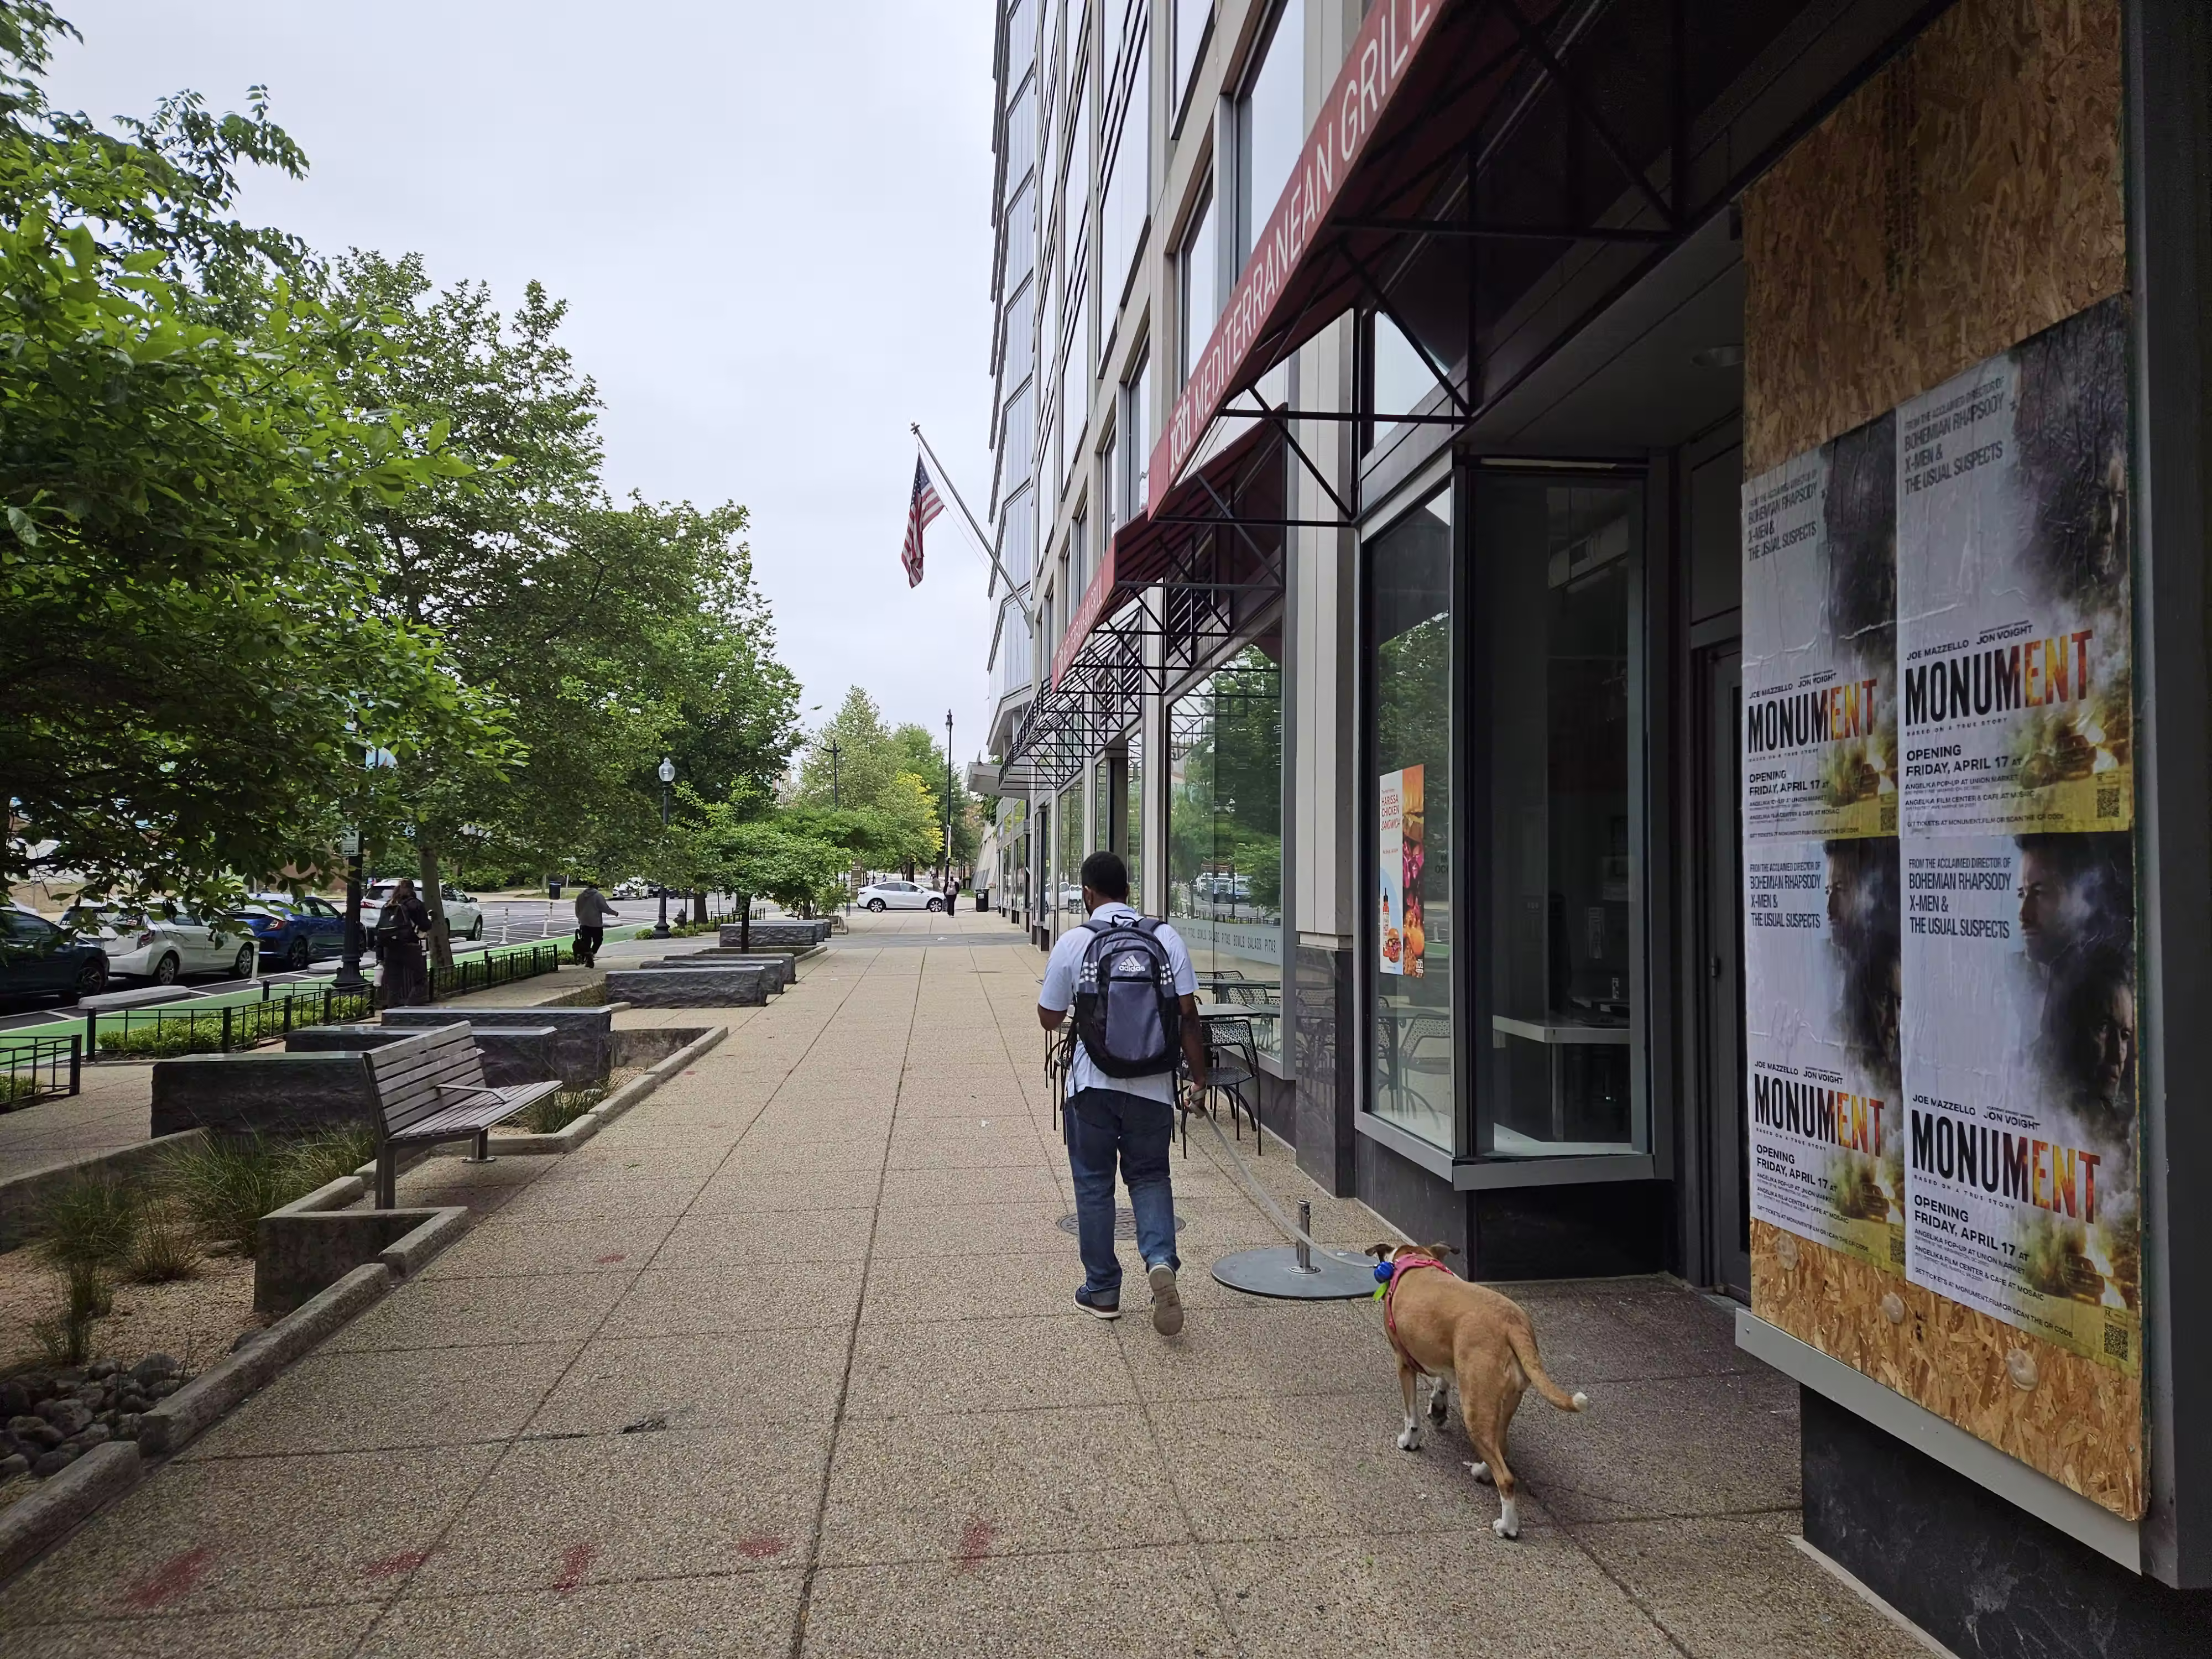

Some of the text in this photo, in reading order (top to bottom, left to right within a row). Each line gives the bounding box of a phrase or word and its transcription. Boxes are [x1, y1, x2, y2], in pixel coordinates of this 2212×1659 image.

[1194, 122, 1332, 432] MEDITERRANEAN
[1341, 0, 1430, 161] GRILL
[1905, 392, 2004, 452] BOHEMIAN RHAPSODY
[1905, 444, 1943, 474] X-MEN &
[1905, 440, 2002, 495] THE USUAL SUSPECTS
[1748, 545, 1760, 561] THE
[1782, 521, 1816, 547] SUSPECTS
[1976, 633, 1995, 645] JON
[1997, 625, 2033, 640] VOIGHT
[1907, 640, 1969, 661] JOE MAZZELLO
[1906, 629, 2093, 726] MONUMENT
[1749, 678, 1877, 753] MONUMENT
[1907, 744, 1961, 761] OPENING
[1750, 770, 1786, 783] OPENING
[1906, 761, 1950, 777] FRIDAY,
[1954, 758, 1991, 773] APRIL
[1995, 756, 2008, 768] 17
[1750, 784, 1778, 796] FRIDAY,
[1781, 781, 1807, 792] APRIL
[1811, 780, 1820, 789] 17
[1381, 794, 1399, 806] HARISSA
[1381, 805, 1400, 817] CHICKEN
[1909, 858, 2011, 868] FROM THE ACCLAIMED DIRECTOR OF
[1750, 874, 1820, 889] BOHEMIAN RHAPSODY
[1909, 873, 2011, 890] BOHEMIAN RHAPSODY
[1751, 894, 1778, 908] X-MEN &
[1910, 895, 1948, 912] X-MEN &
[1751, 912, 1820, 928] THE USUAL SUSPECTS
[1910, 917, 2009, 938] THE USUAL SUSPECTS
[1767, 1063, 1798, 1075] MAZZELLO
[1803, 1071, 1817, 1079] JON
[1818, 1073, 1843, 1084] VOIGHT
[1755, 1073, 1885, 1157] MONUMENT
[1913, 1095, 1929, 1104] JOE
[1931, 1098, 1975, 1115] MAZZELLO
[1984, 1111, 2002, 1122] JON
[2005, 1115, 2041, 1130] VOIGHT
[1757, 1144, 1794, 1164] OPENING
[1757, 1157, 1787, 1177] FRIDAY,
[1790, 1168, 1815, 1185] APRIL
[1818, 1178, 1828, 1188] 17
[1912, 1109, 2100, 1224] MONUMENT
[1914, 1175, 1938, 1185] BASED
[1989, 1198, 2015, 1210] STORY
[1914, 1194, 1969, 1222] OPENING
[1915, 1210, 1958, 1237] FRIDAY,
[1961, 1227, 1998, 1250] APRIL
[2001, 1242, 2016, 1256] 17
[2018, 1252, 2030, 1261] AT
[1915, 1229, 1943, 1244] ANGELIKA
[1945, 1239, 1966, 1253] POP-UP
[1977, 1251, 1997, 1265] UNION
[1999, 1260, 2026, 1275] MARKET
[1915, 1245, 1943, 1261] ANGELIKA
[1945, 1257, 1958, 1267] FILM
[1960, 1262, 1984, 1277] CENTER
[2018, 1286, 2044, 1301] MOSAIC
[1925, 1271, 1947, 1285] TICKETS
[2013, 1307, 2029, 1320] SCAN
[2031, 1315, 2043, 1325] THE
[2055, 1326, 2073, 1339] CODE
